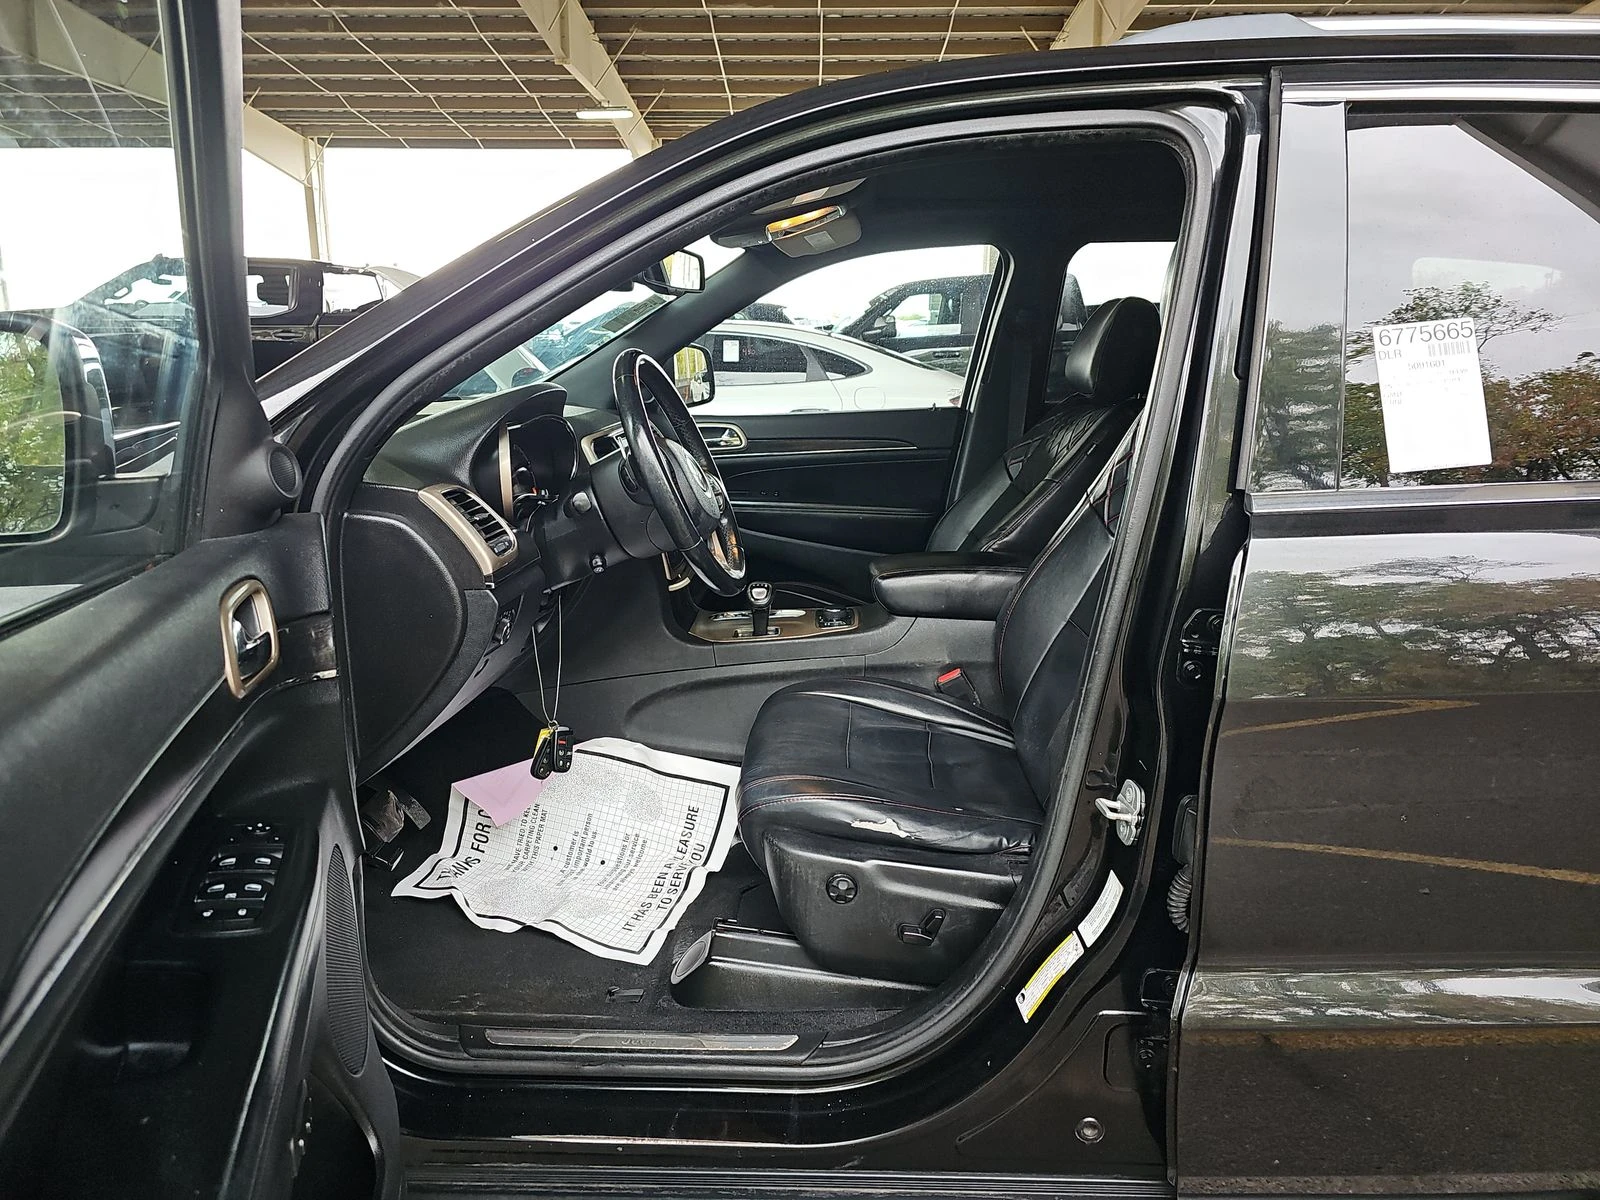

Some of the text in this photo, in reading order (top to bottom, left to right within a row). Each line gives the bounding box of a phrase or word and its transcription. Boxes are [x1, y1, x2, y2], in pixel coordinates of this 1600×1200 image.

[1379, 321, 1473, 346] 6775665
[1378, 349, 1402, 361] DLR
[471, 821, 491, 853] FOR
[516, 828, 525, 846] TRIED
[521, 818, 527, 827] TO
[522, 825, 535, 859] CARPETING
[530, 803, 540, 823] CLEAN
[534, 823, 544, 844] PAPER
[539, 808, 547, 822] MAT
[582, 813, 592, 835] person
[563, 838, 576, 868] customer
[582, 848, 592, 867] world
[588, 839, 594, 847] to
[628, 832, 639, 857] service
[622, 920, 635, 932] IT
[631, 900, 652, 921] HAS
[648, 870, 669, 899] BEEN
[657, 895, 672, 911] TO
